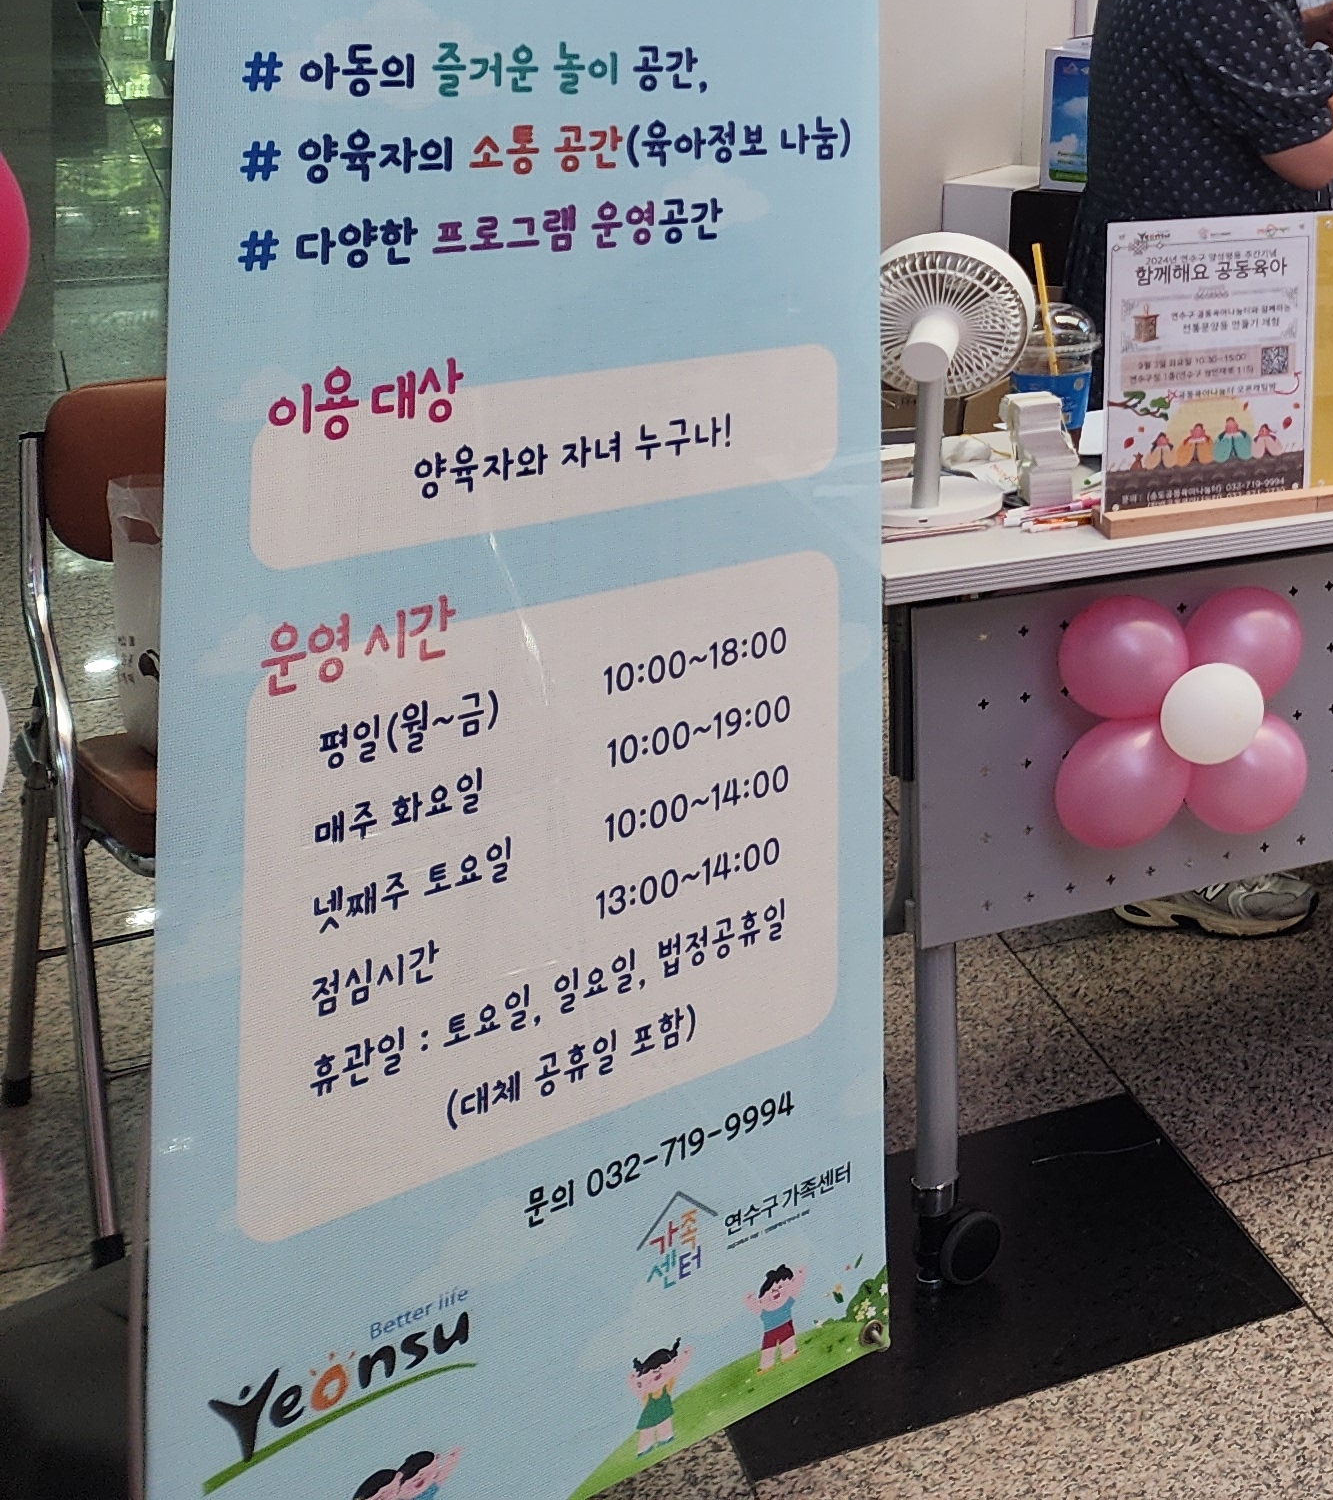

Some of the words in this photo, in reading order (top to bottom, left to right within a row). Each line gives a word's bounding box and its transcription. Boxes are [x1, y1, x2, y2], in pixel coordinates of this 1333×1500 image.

[299, 42, 416, 98] 아동의
[431, 40, 540, 98] 즐거운
[553, 40, 620, 95] 놀이
[632, 44, 709, 95] 공간,
[298, 128, 454, 185] 양육자의
[468, 123, 540, 177] 소통
[780, 116, 853, 162] 나눔)
[295, 216, 419, 269] 다양한
[431, 203, 578, 255] 프로그램
[590, 197, 724, 251] 운영공간
[1135, 262, 1209, 286] 함께해요
[1215, 257, 1288, 281] 공동육아
[267, 364, 360, 441] 이용
[370, 357, 465, 424] 대상
[412, 443, 550, 500] 양육자와
[560, 429, 623, 470] 자녀
[635, 412, 733, 460] 누구나!
[260, 612, 352, 698] 운영
[363, 595, 457, 662] 시간
[318, 688, 502, 771] 평일(월~금)
[602, 625, 789, 696] 10:00~18:00
[313, 800, 379, 846] 매주
[391, 766, 486, 827] 화요일
[606, 694, 792, 769] 10:00~19:00
[312, 871, 410, 934] 넷째주
[423, 835, 514, 900] 토요일
[604, 763, 791, 844] 10:00~14:00
[310, 938, 441, 1019] 점심시간
[594, 836, 782, 920] 13:00~14:00
[309, 1026, 406, 1098] 휴관일
[443, 984, 543, 1049] 토요일,
[553, 948, 647, 1001] 일요일,
[657, 898, 787, 977] 법정공휴일
[445, 1072, 523, 1131] (대체
[536, 1029, 619, 1102] 공휴일
[630, 1004, 700, 1060] 포함)
[523, 1179, 575, 1230] 문의
[586, 1088, 797, 1198] 032-719-9994
[724, 1194, 779, 1236] 연수구
[782, 1161, 851, 1208] 가족센터
[647, 1245, 701, 1289] 센터
[649, 1208, 698, 1255] 가족
[369, 1307, 434, 1344] Better
[436, 1284, 471, 1318] life
[207, 1309, 471, 1464] Yeonsu
